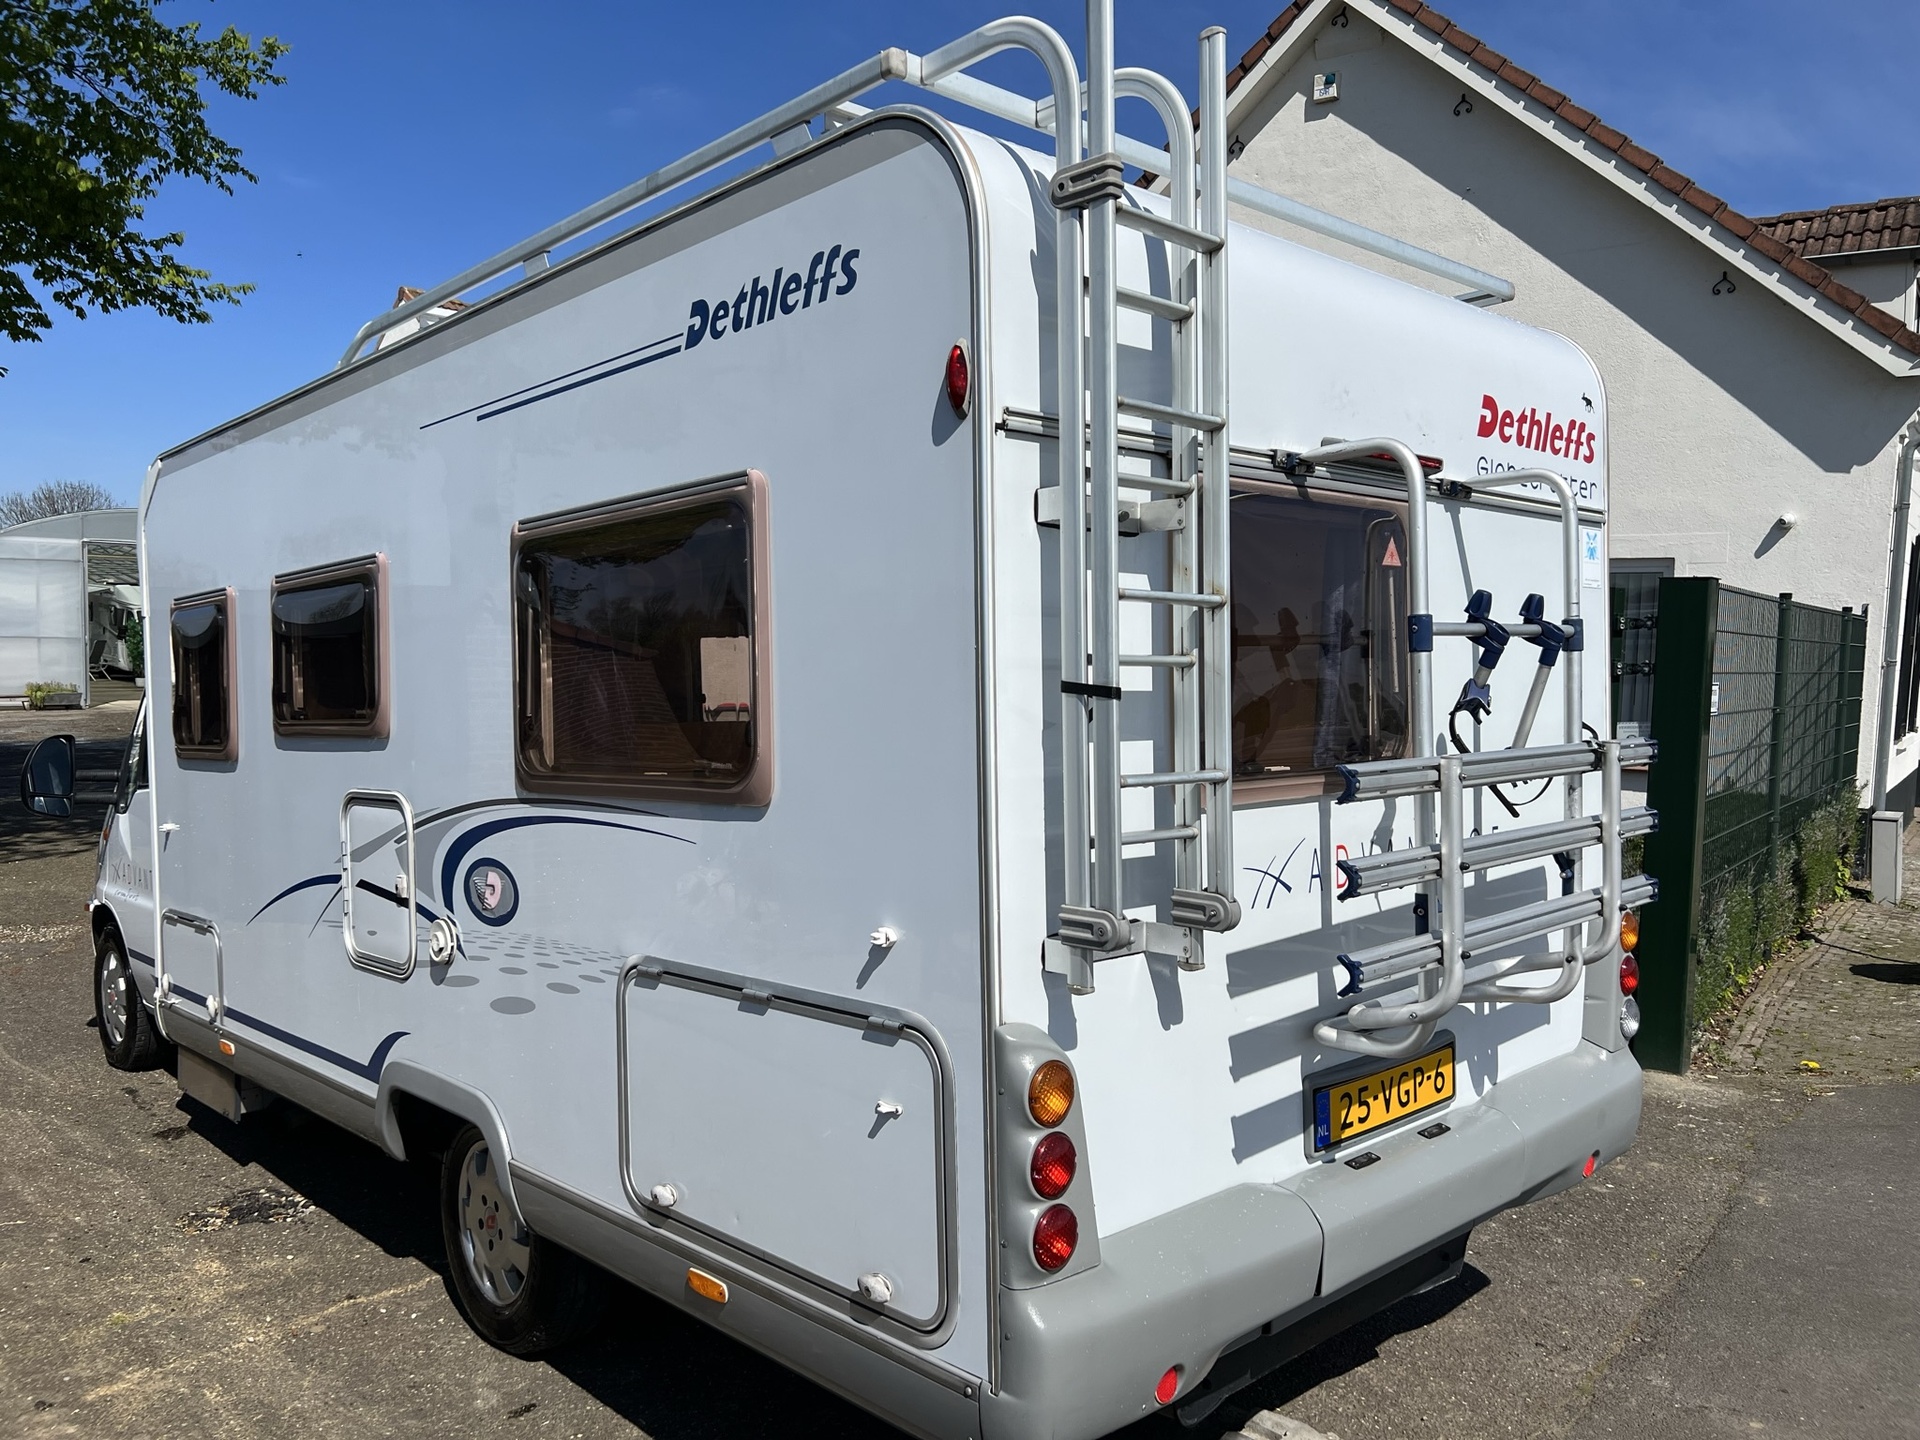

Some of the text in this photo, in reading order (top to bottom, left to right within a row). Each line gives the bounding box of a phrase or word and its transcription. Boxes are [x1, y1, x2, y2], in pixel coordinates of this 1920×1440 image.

[684, 244, 861, 351] Dethleffs
[1477, 394, 1596, 464] Dethleffs
[1340, 1058, 1445, 1131] 25-VGP-6
[1318, 1126, 1329, 1138] NL
